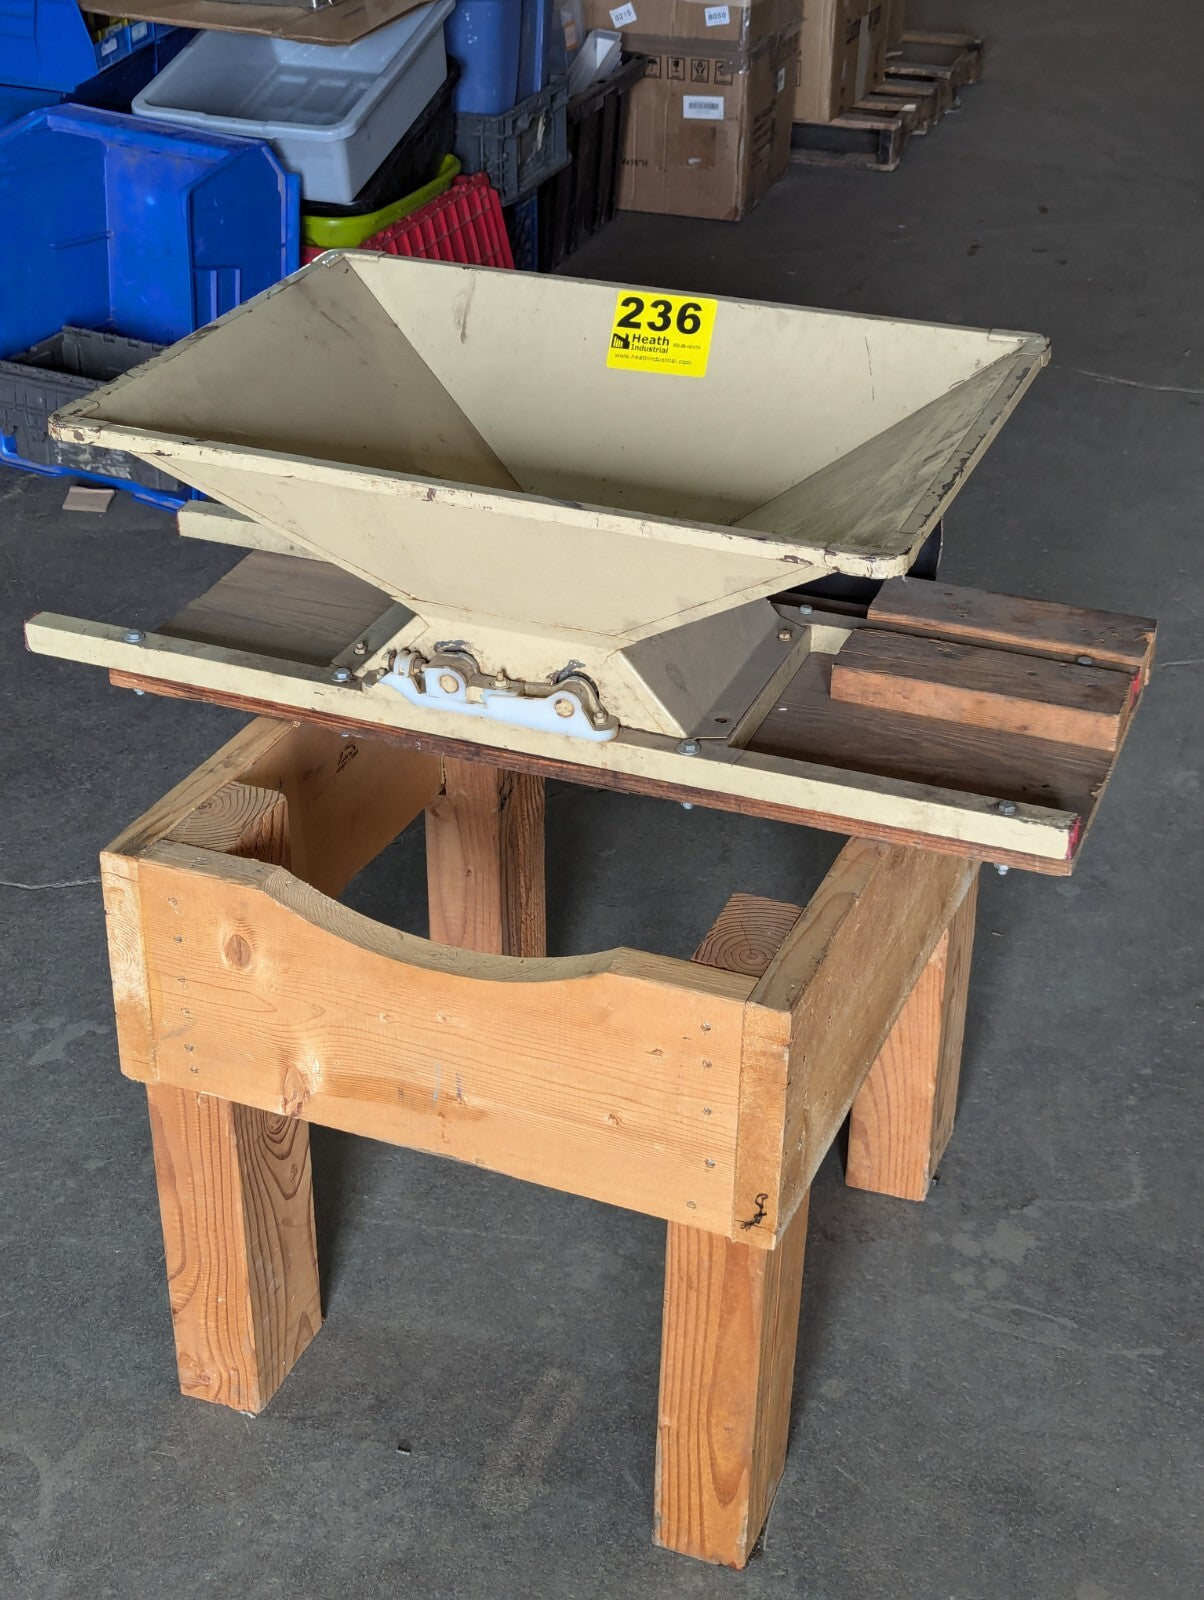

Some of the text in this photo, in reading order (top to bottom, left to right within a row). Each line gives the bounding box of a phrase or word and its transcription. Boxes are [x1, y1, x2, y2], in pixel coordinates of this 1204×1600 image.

[616, 297, 702, 334] 236
[632, 333, 670, 346] Heath
[630, 343, 669, 355] Industrial
